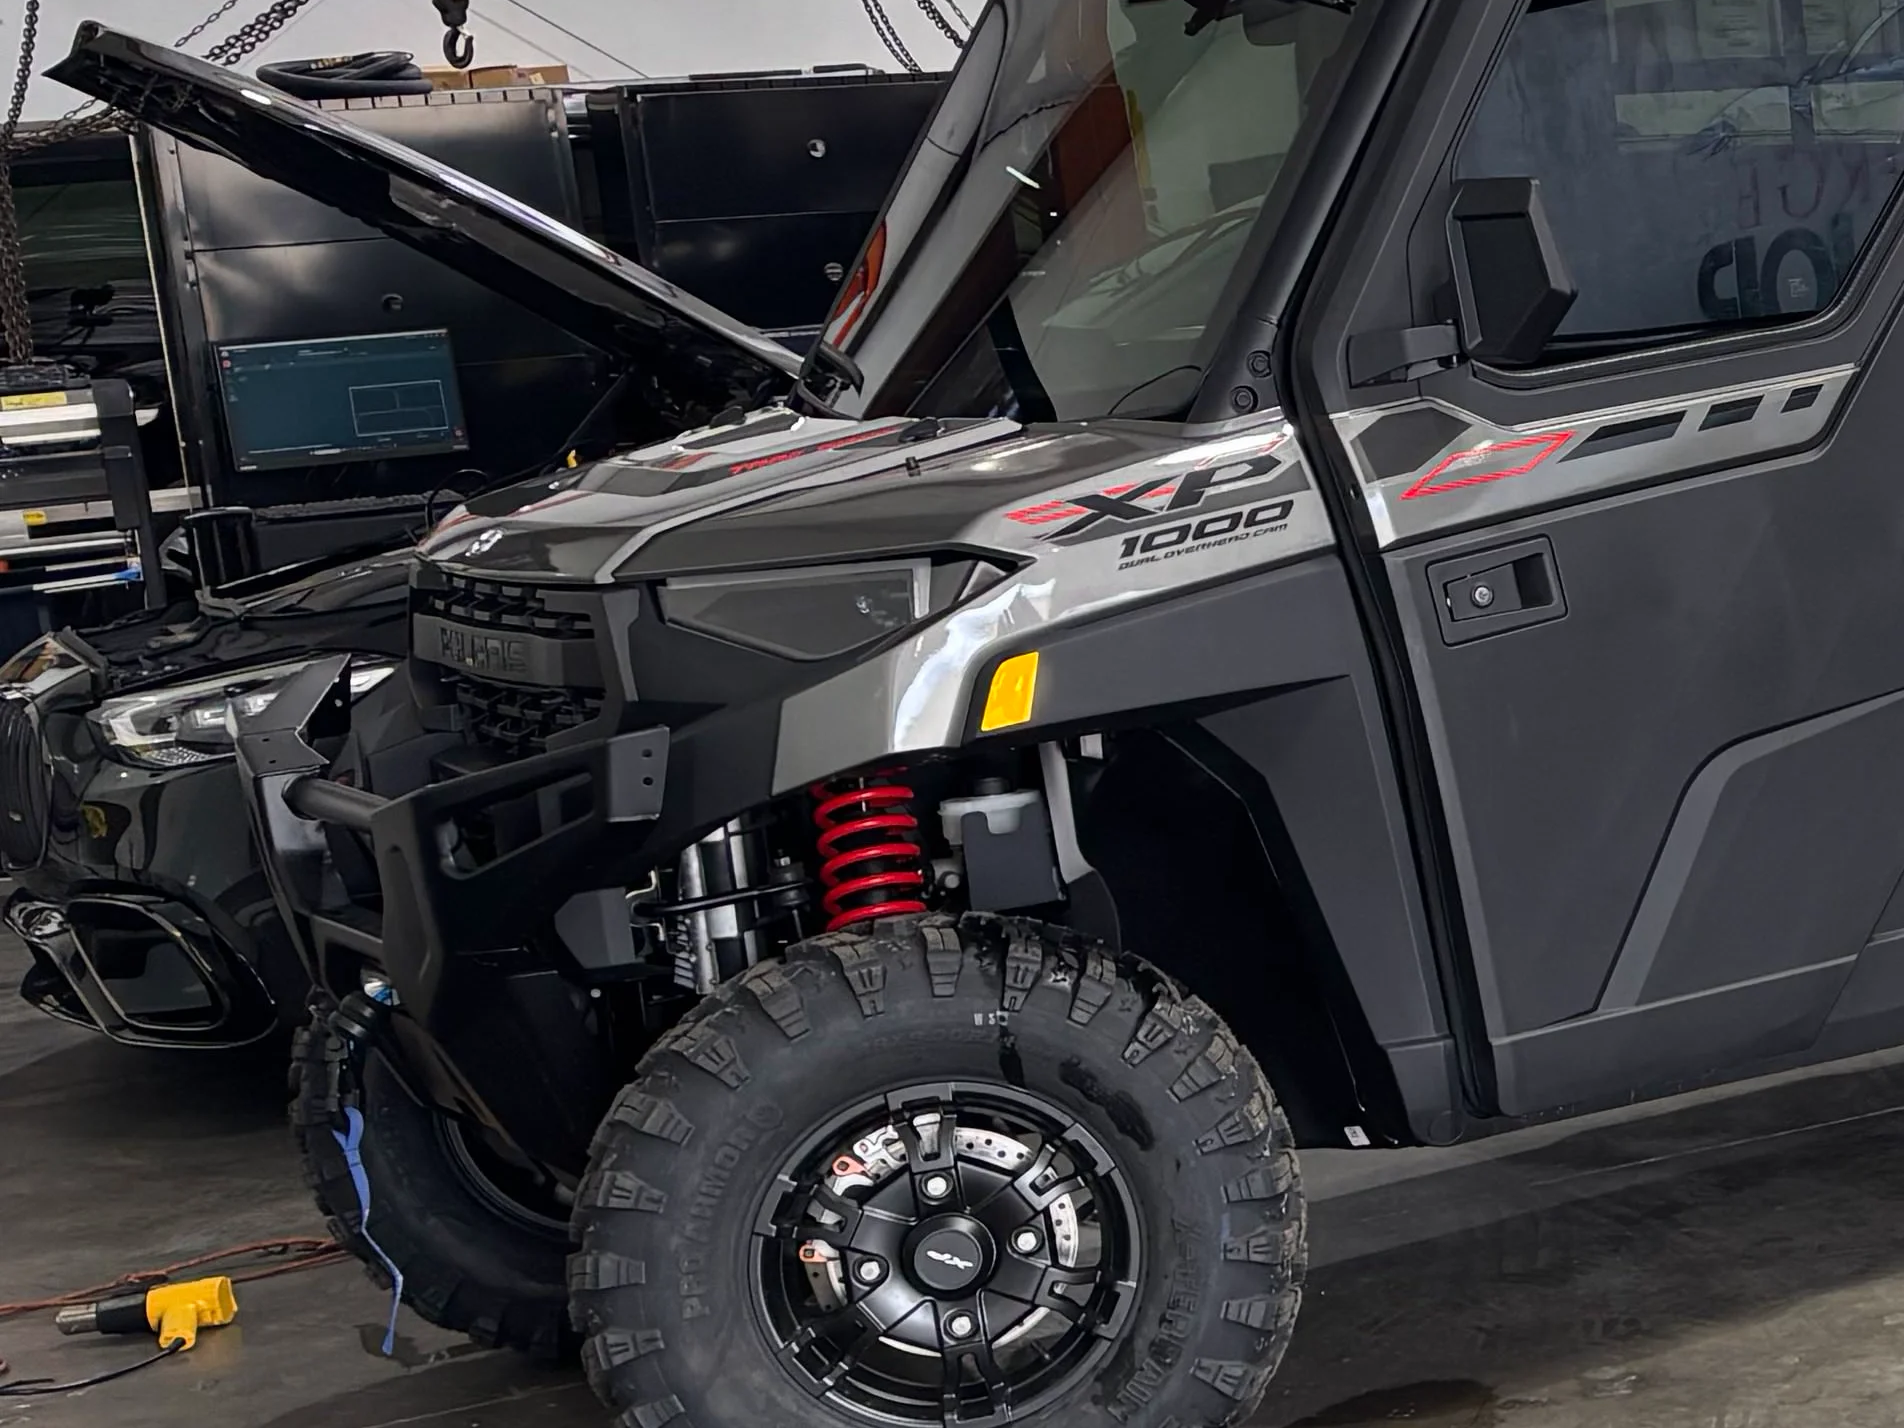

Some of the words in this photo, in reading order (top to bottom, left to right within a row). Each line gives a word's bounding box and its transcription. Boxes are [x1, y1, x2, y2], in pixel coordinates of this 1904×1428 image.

[1040, 454, 1282, 541] XP
[1117, 554, 1161, 571] DUAL
[1163, 533, 1250, 560] OVERHEAD
[1252, 523, 1288, 538] CAM
[1119, 499, 1294, 560] 1000
